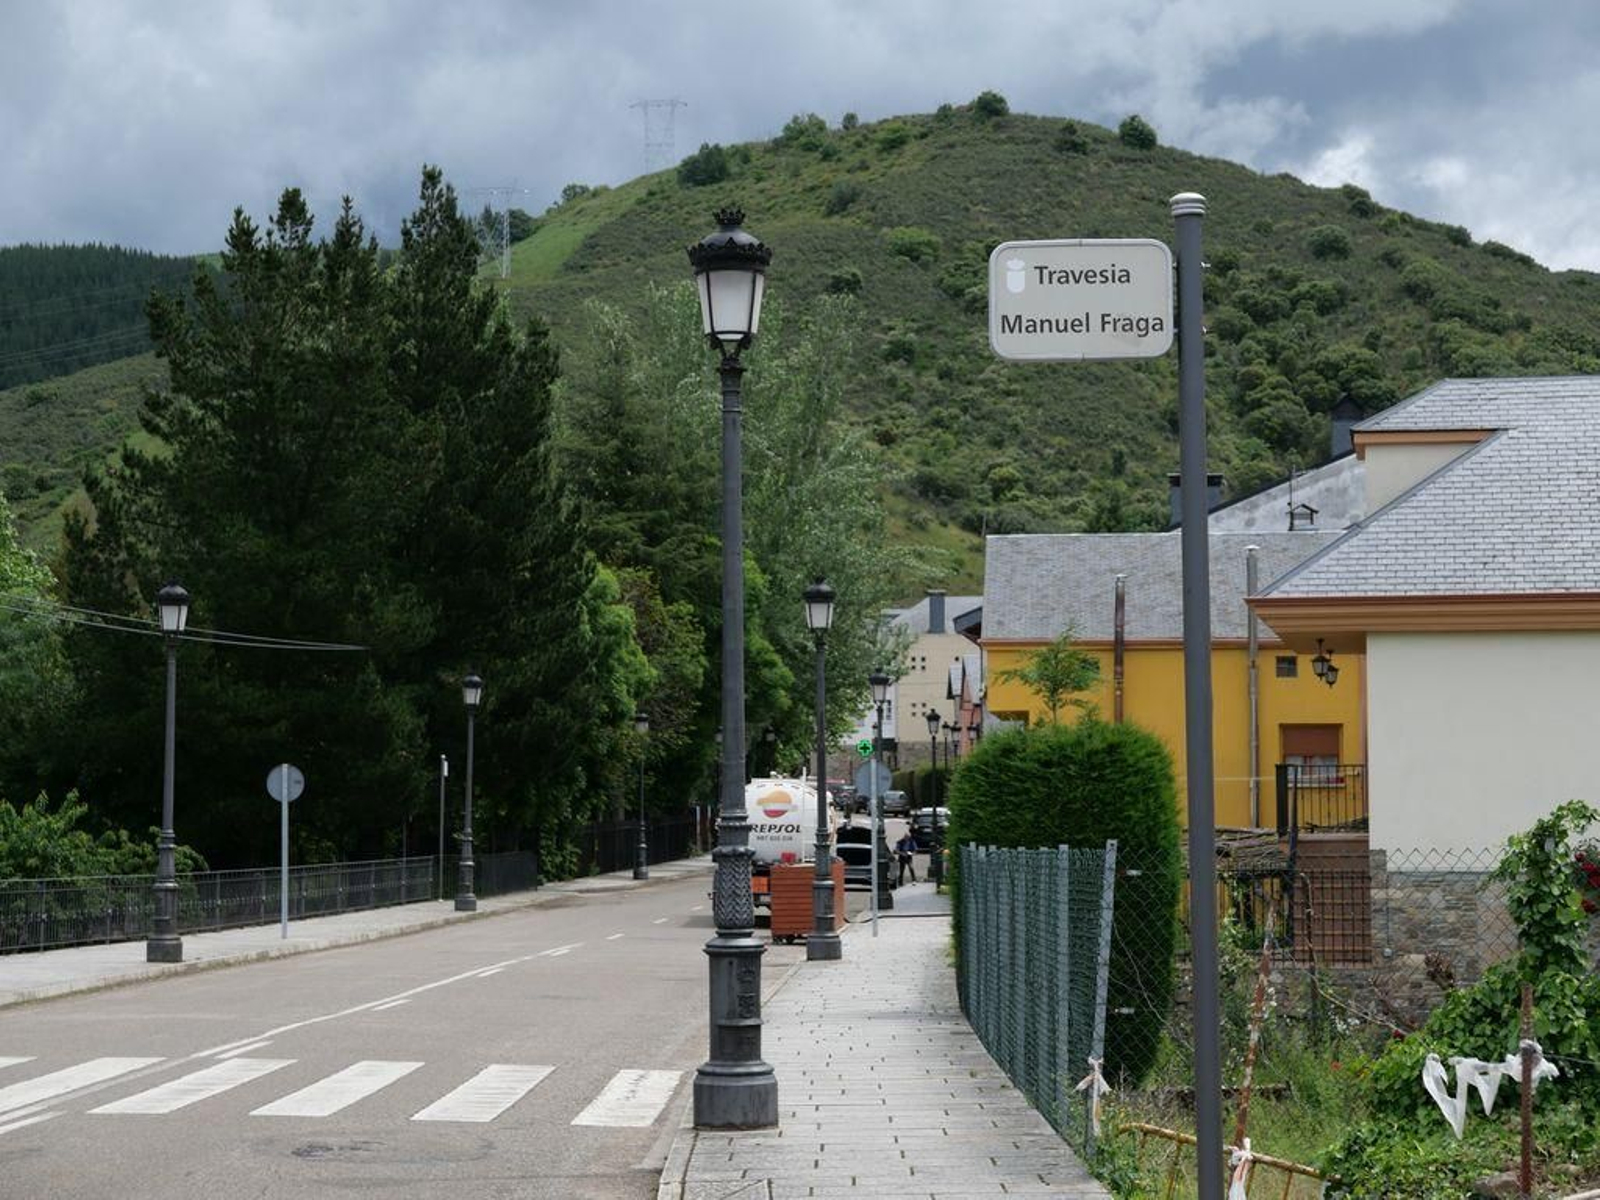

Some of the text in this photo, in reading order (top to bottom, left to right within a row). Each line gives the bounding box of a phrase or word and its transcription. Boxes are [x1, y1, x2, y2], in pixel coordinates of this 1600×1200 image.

[1034, 263, 1131, 285] Travesia
[1001, 312, 1164, 338] Manuel Fraga
[749, 824, 801, 833] REPSOL
